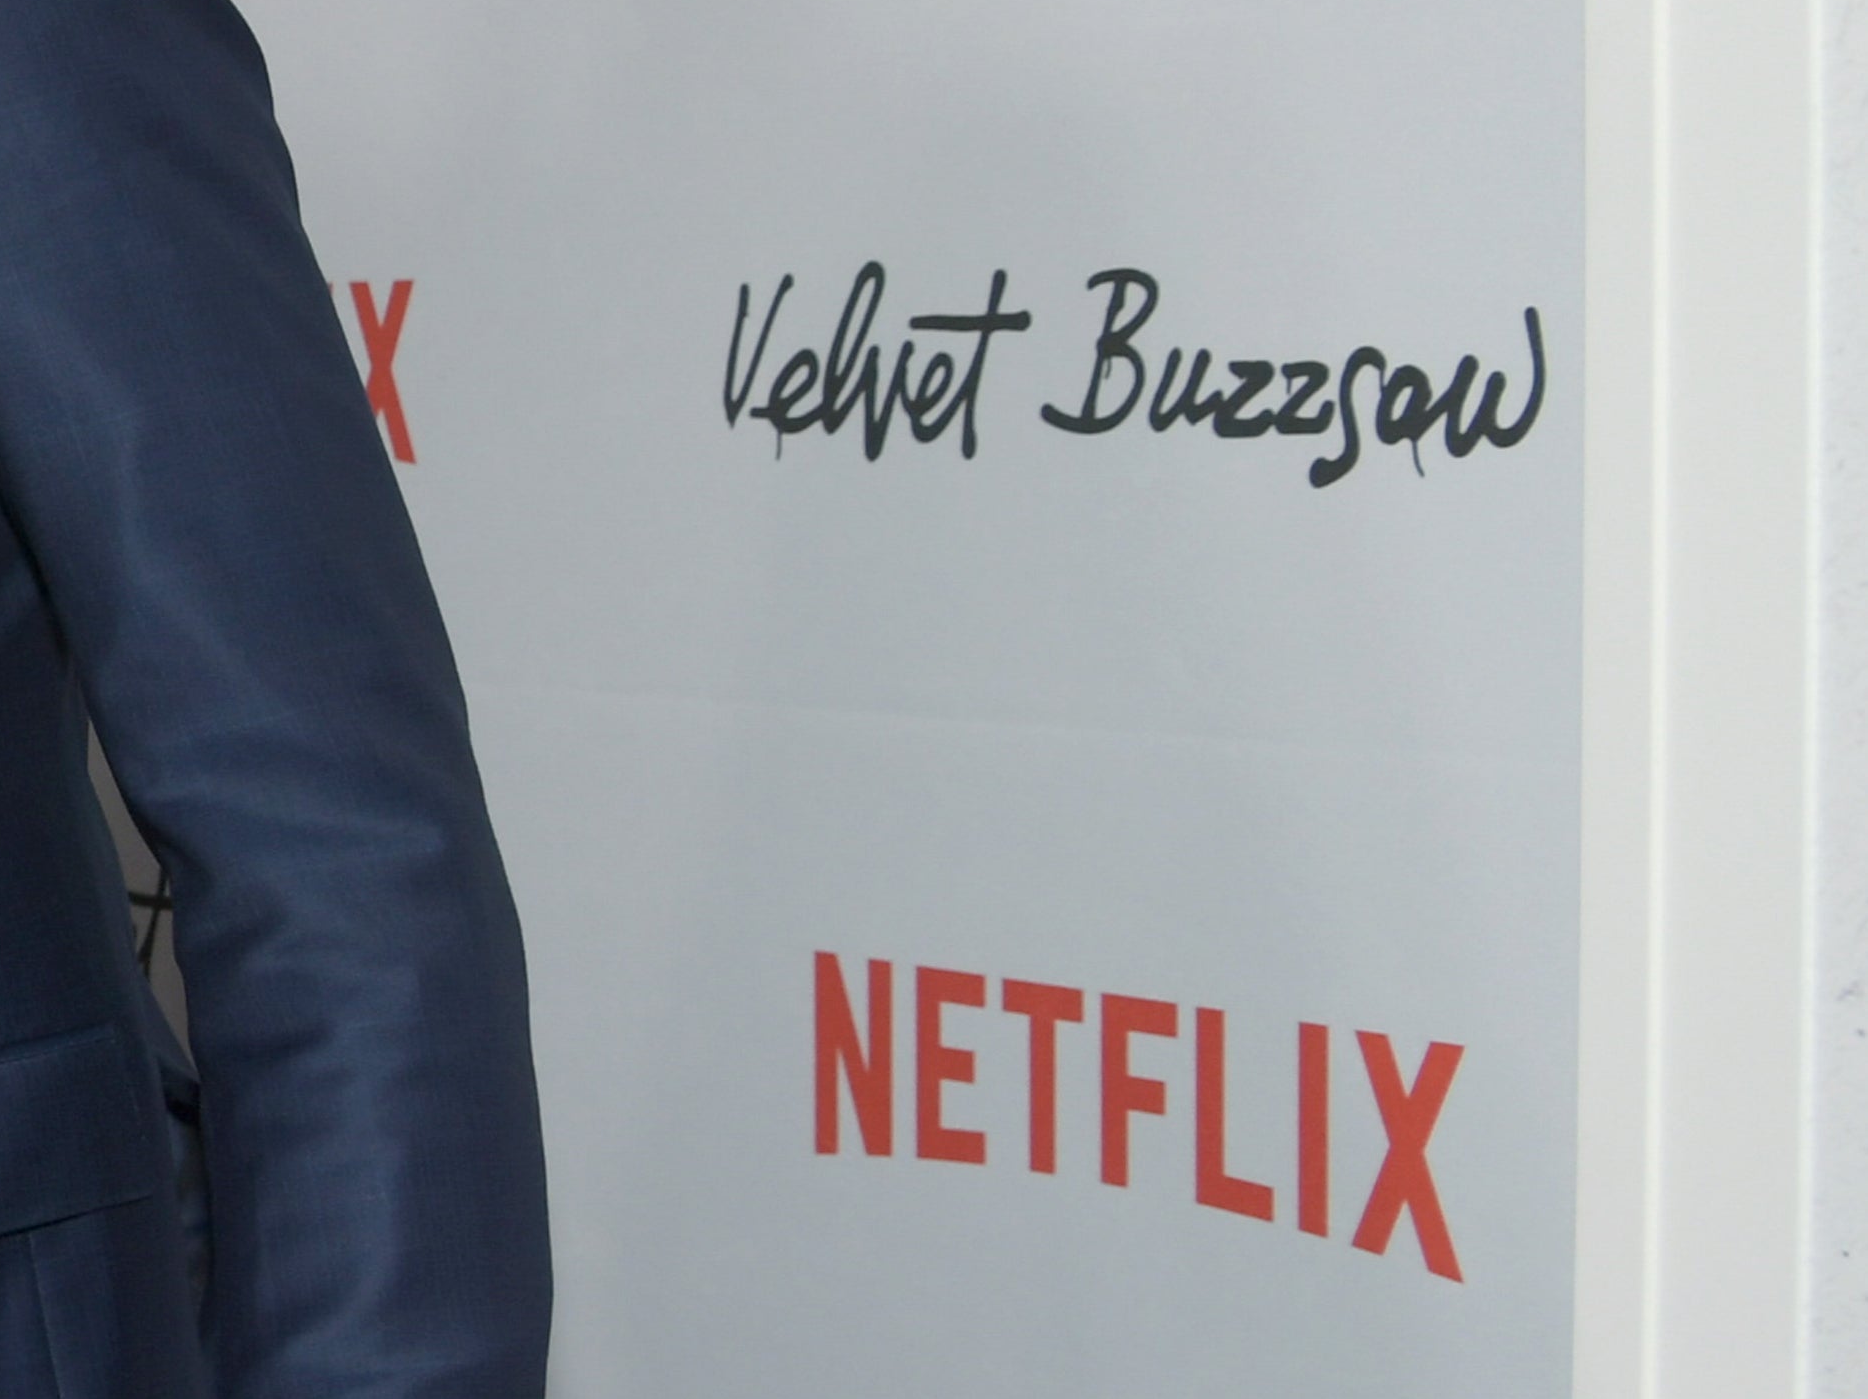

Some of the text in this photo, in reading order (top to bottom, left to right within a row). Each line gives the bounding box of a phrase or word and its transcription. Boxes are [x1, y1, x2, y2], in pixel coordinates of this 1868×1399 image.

[722, 260, 1547, 489] Velvet Buzzsaw
[813, 950, 1466, 1284] NETFLIX
